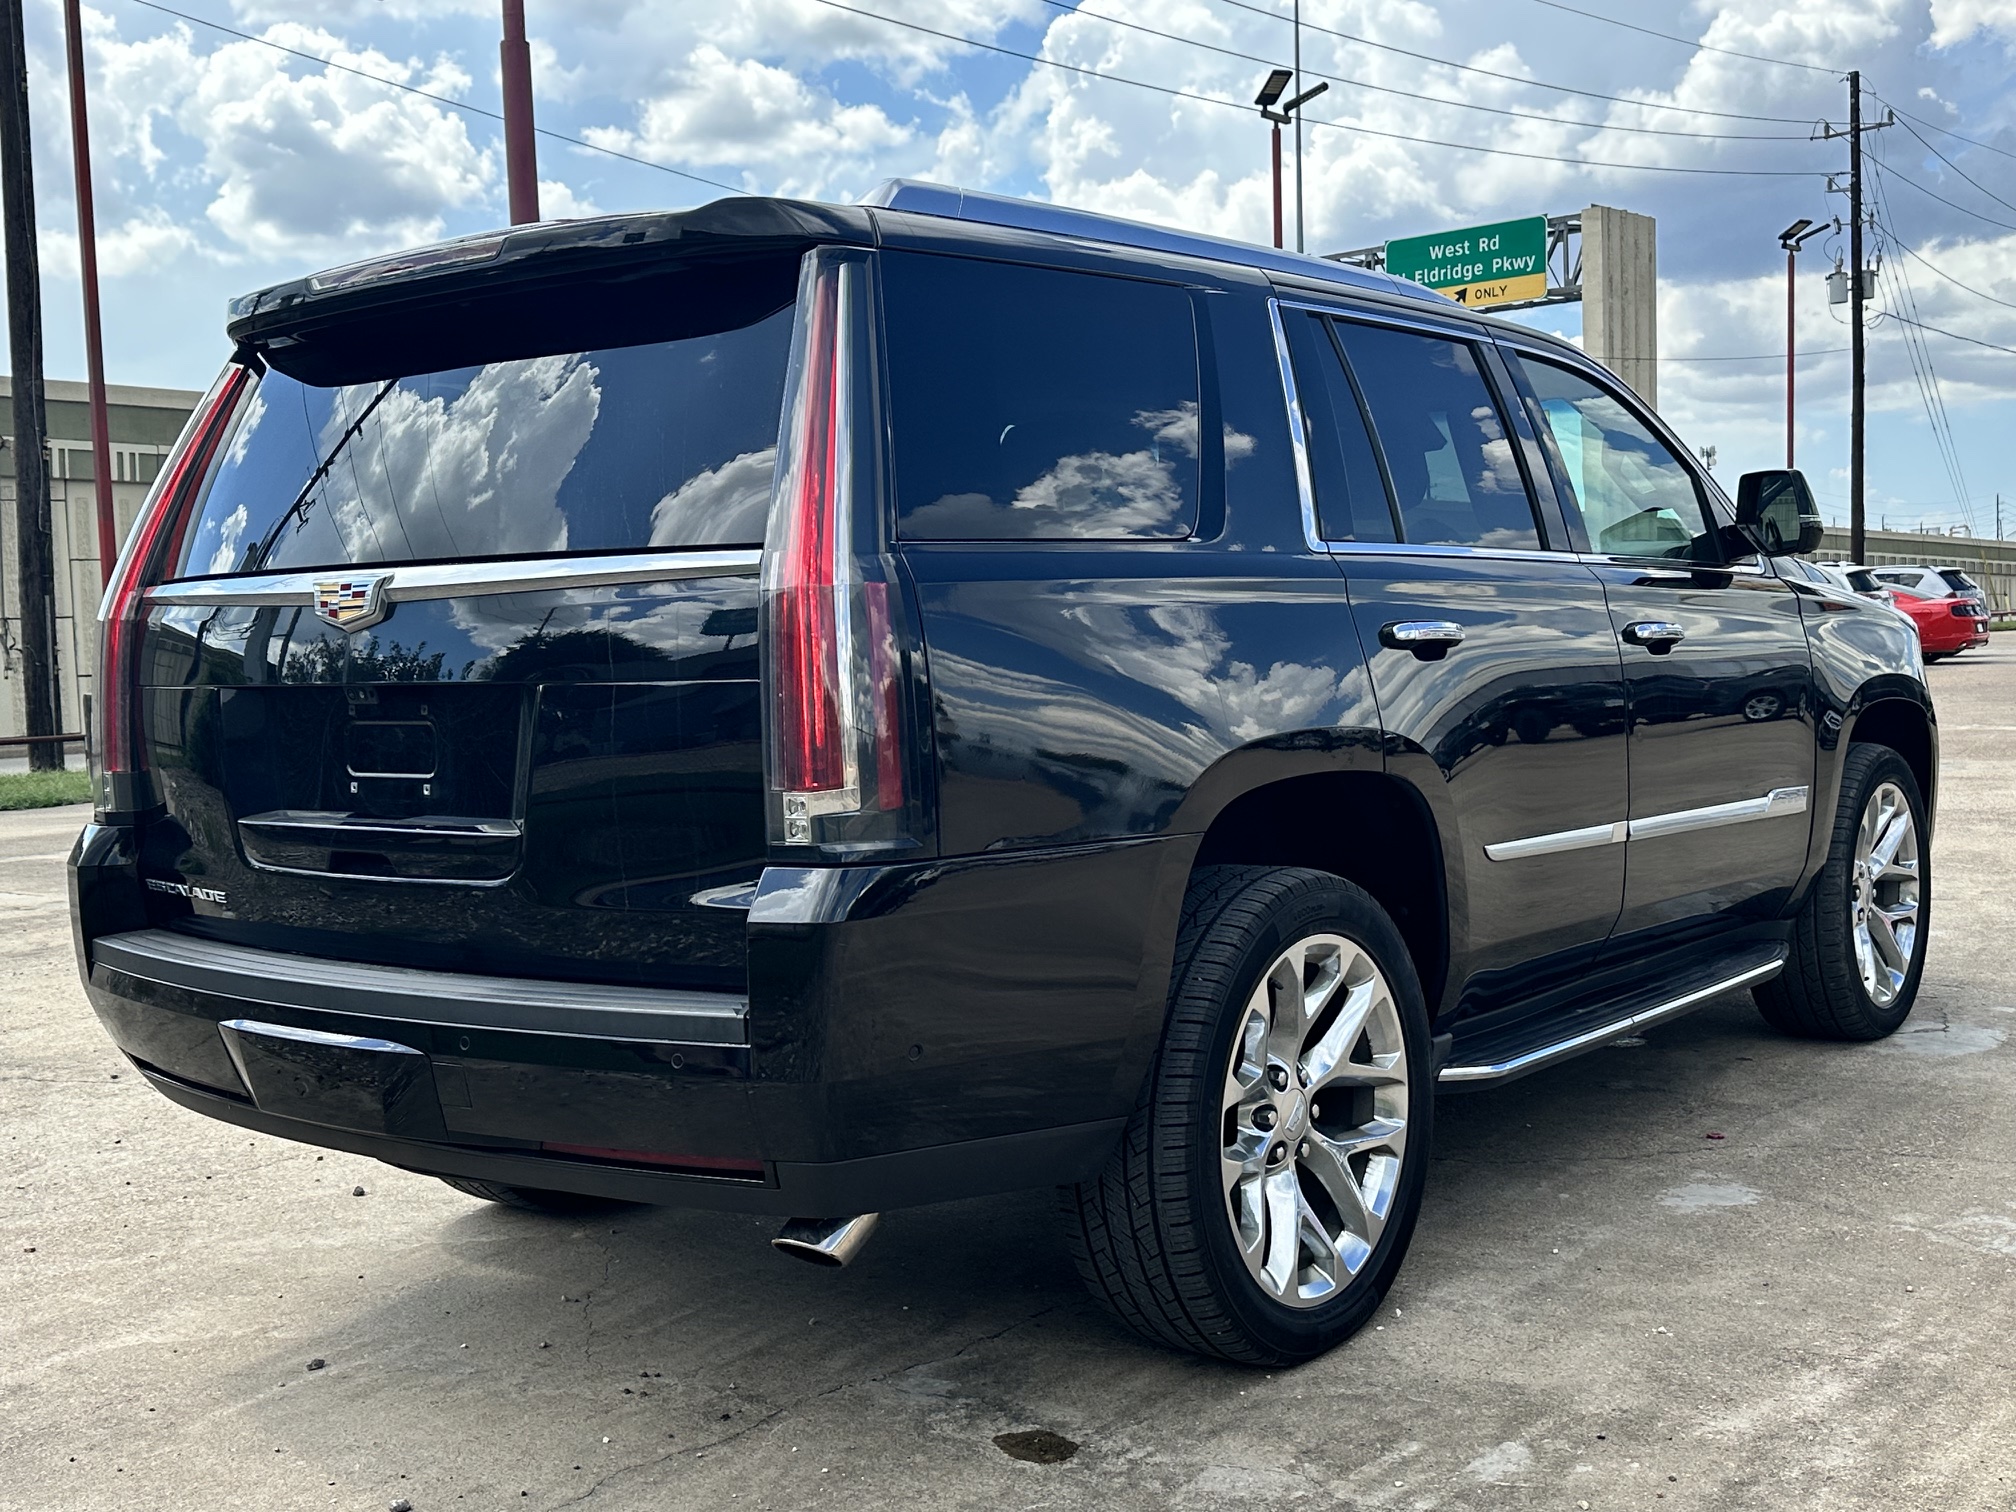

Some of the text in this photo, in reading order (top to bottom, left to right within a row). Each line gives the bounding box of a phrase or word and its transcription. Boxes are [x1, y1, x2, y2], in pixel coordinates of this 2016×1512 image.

[1429, 235, 1500, 260] West Rd
[1414, 255, 1535, 285] Eldridge Pkwy
[1475, 285, 1508, 300] ONLY
[145, 878, 227, 903] ESCALADE
